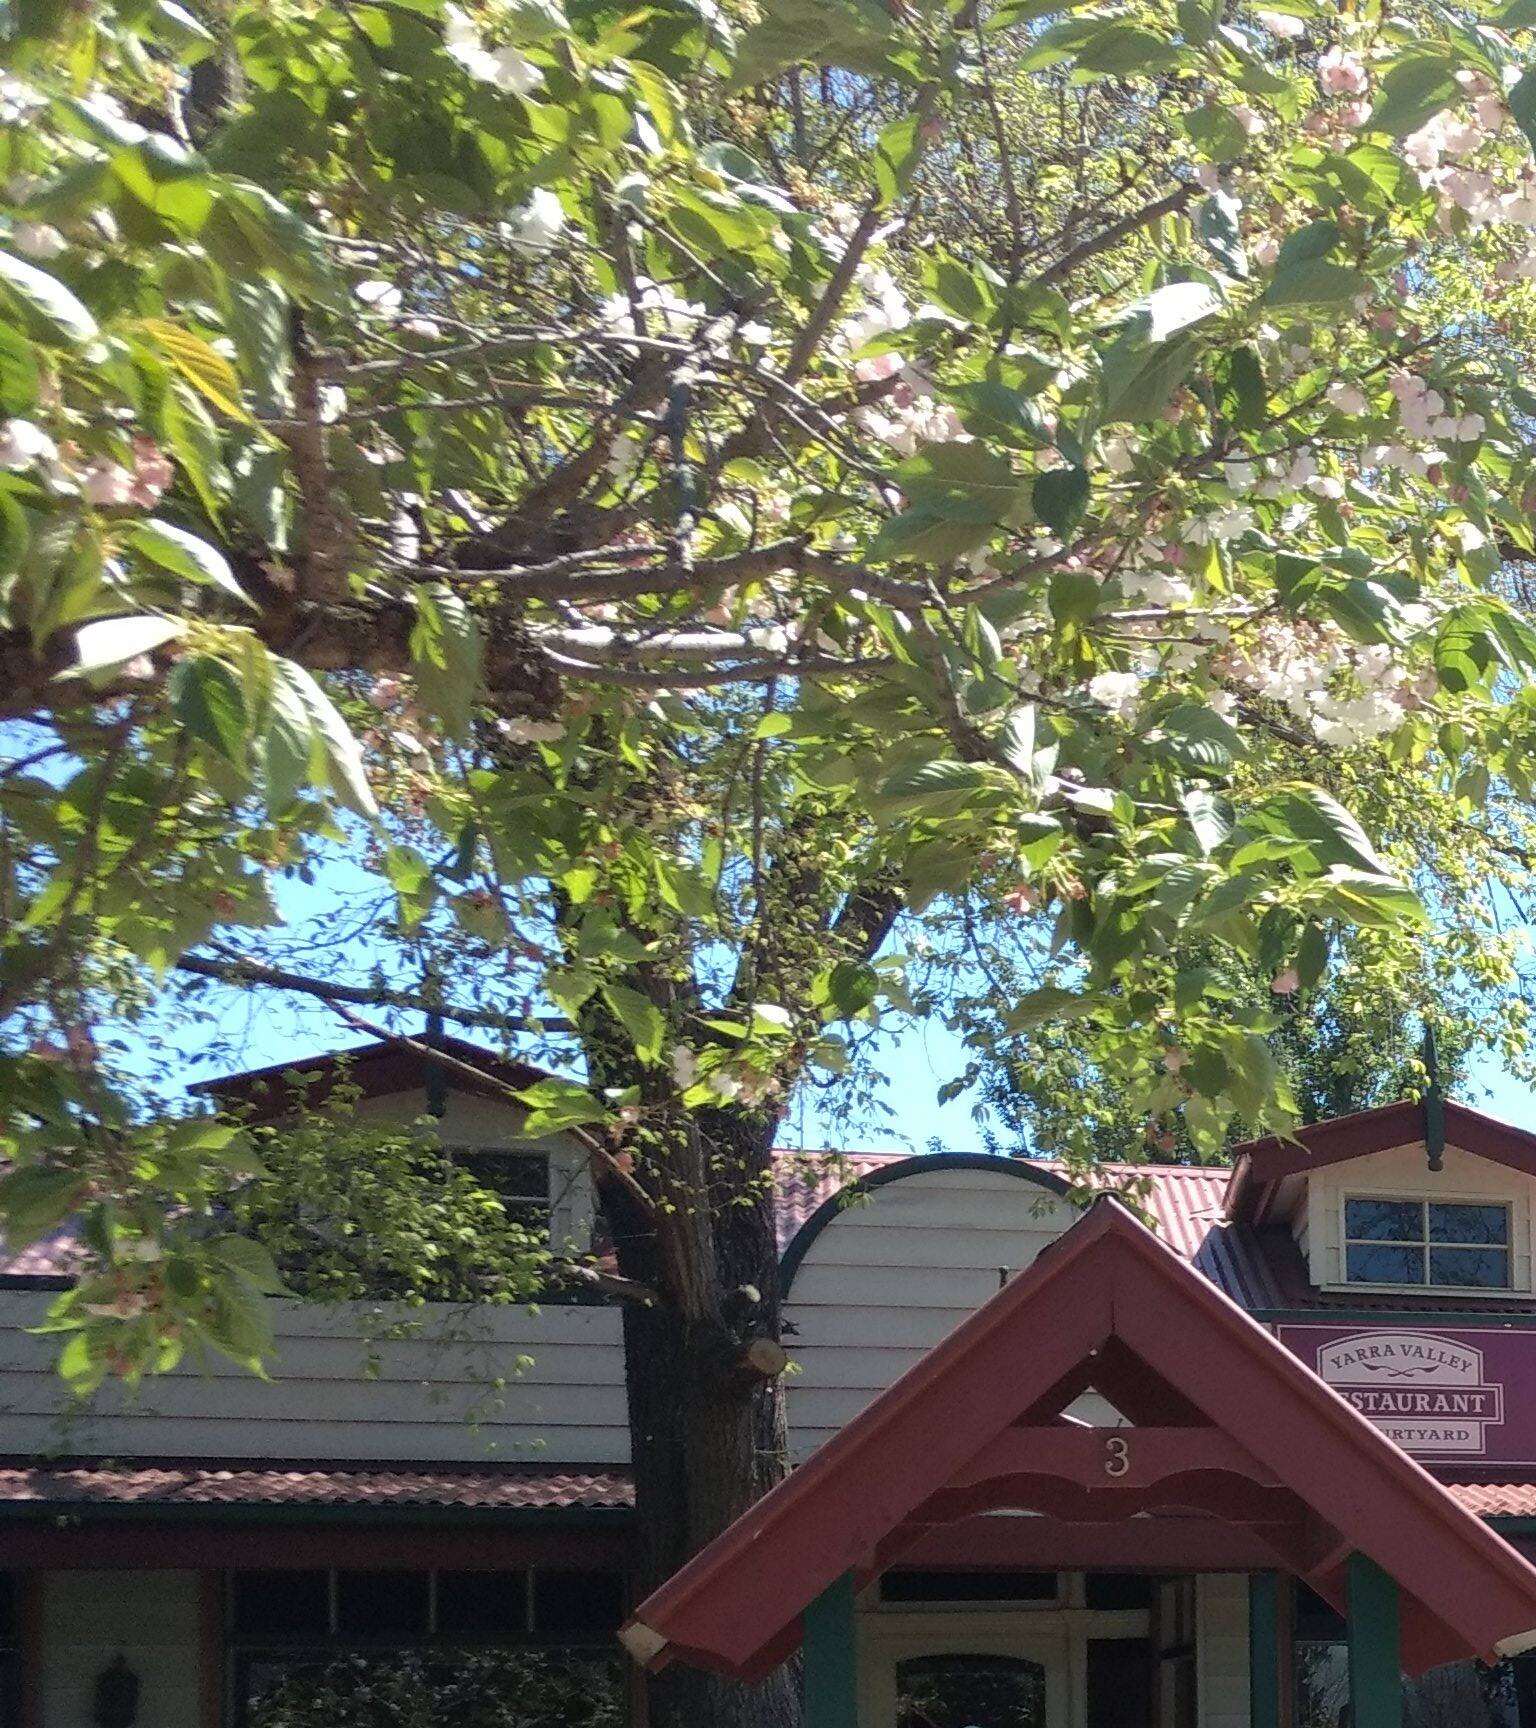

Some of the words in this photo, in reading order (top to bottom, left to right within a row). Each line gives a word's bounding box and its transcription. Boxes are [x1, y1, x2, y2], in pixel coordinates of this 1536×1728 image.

[1331, 1344, 1396, 1370] YARRA
[1399, 1344, 1473, 1374] VALLEY
[1105, 1437, 1129, 1477] 3
